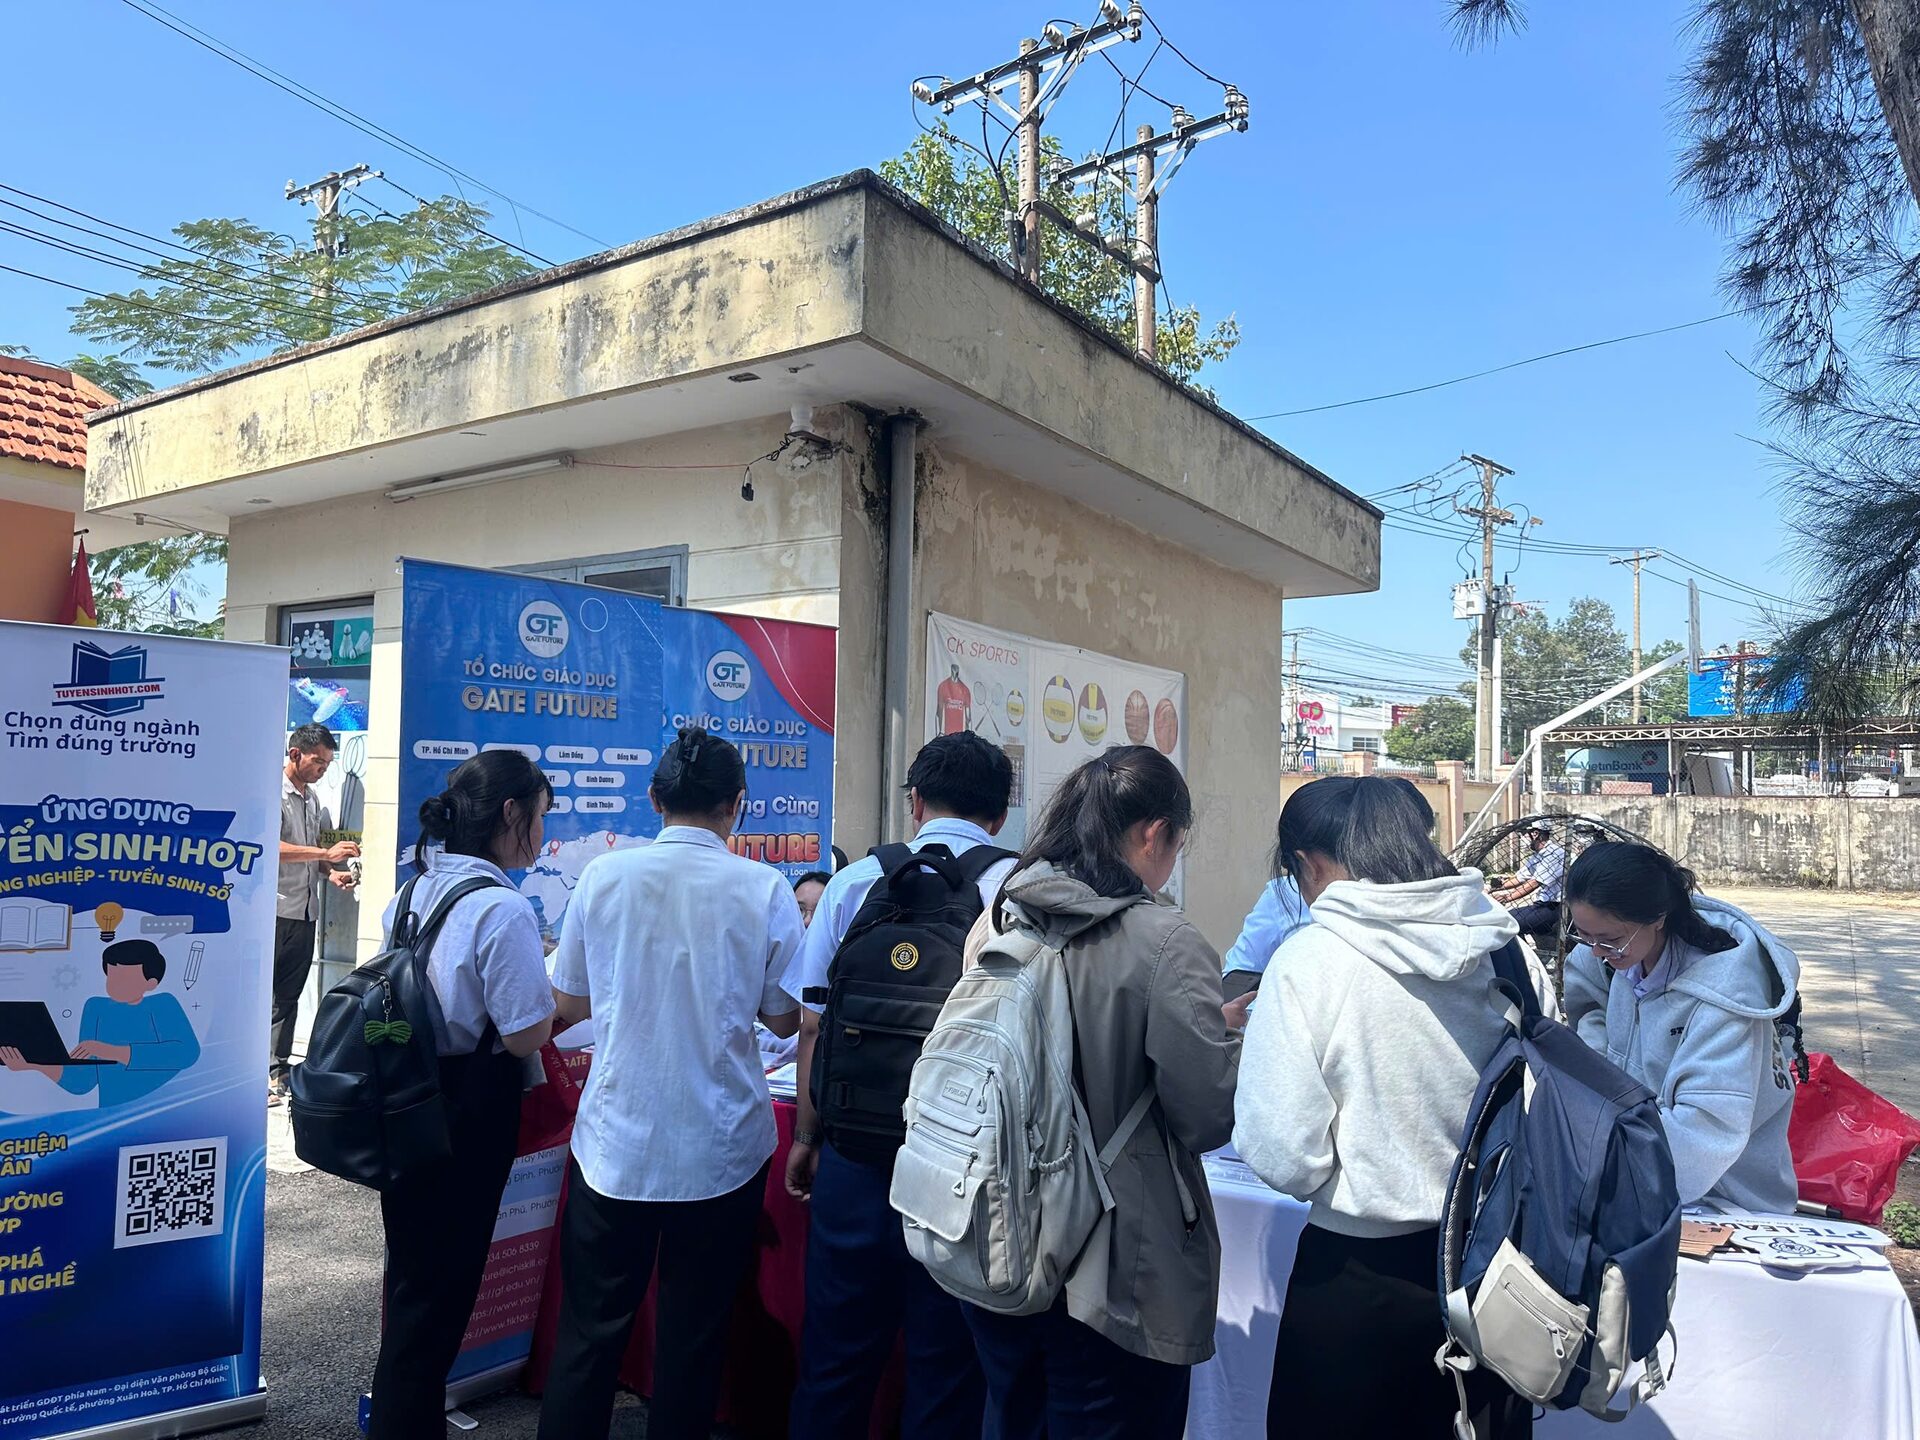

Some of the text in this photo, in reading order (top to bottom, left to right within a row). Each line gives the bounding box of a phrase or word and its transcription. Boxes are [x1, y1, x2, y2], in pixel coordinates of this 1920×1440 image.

[947, 636, 1019, 666] CK SPORTS
[463, 654, 617, 690] TỔ CHỨC GIÁO DỤC
[56, 684, 160, 698] TUYENSINHHOT.COM
[462, 685, 617, 719] GATE FUTURE
[4, 711, 200, 738] Chọn đúng ngành
[727, 715, 770, 734] GIÁO
[774, 719, 806, 739] DỤC
[6, 731, 196, 759] Tìm đúng trường
[454, 747, 469, 755] Minh
[737, 742, 807, 769] UTURE
[1580, 760, 1643, 772] VietinBank
[42, 798, 191, 826] ỨNG DỤNG
[772, 795, 820, 818] Cùng
[0, 818, 260, 872] ỂN SINH HOT
[727, 833, 820, 864] UTURE
[27, 866, 95, 887] NGHIỆP
[108, 865, 164, 886] TUYỂN
[166, 876, 206, 894] SINH
[207, 884, 234, 901] SỐ
[0, 1133, 67, 1156] GHIỆM
[0, 1157, 31, 1176] ÂN
[11, 1261, 77, 1294] NGHỀ
[65, 1390, 85, 1402] phía
[87, 1387, 107, 1397] Nam
[114, 1382, 129, 1392] Đại
[169, 1370, 196, 1383] phòng
[210, 1364, 229, 1373] Giáo
[3, 1412, 37, 1425] trường
[39, 1405, 63, 1418] Quốc
[79, 1397, 115, 1412] phường
[162, 1385, 175, 1393] TP.
